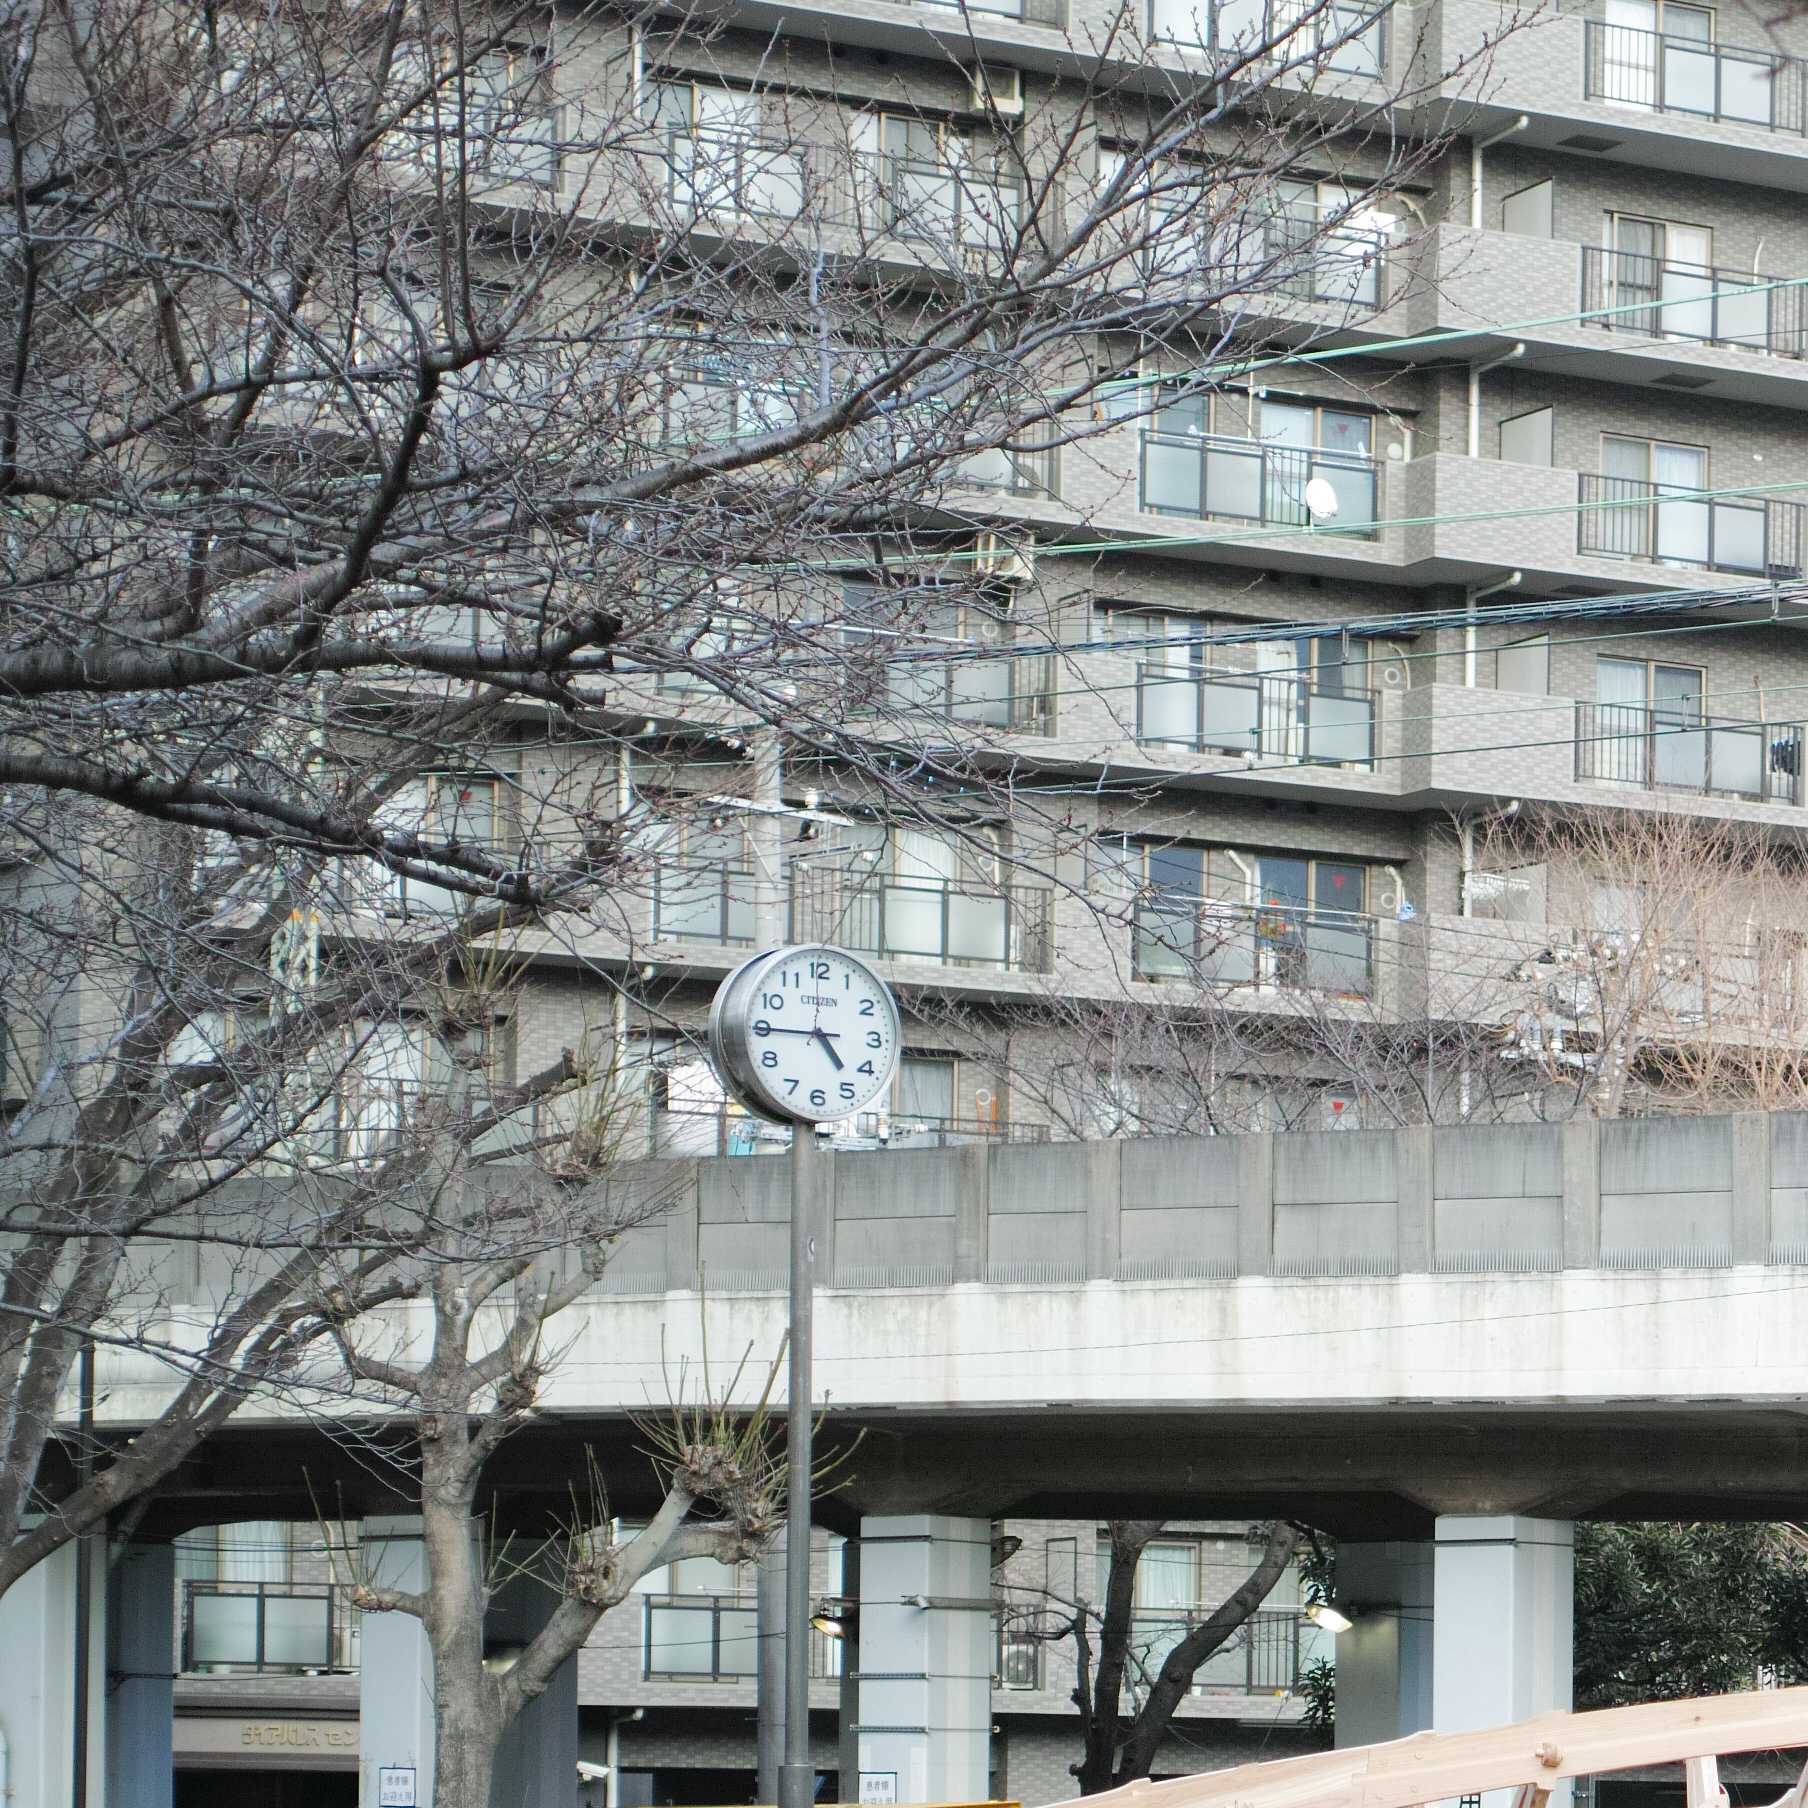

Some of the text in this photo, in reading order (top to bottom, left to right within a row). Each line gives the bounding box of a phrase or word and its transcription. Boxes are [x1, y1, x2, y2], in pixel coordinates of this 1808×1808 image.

[781, 970, 800, 989] 11
[809, 962, 830, 980] 12
[844, 974, 850, 990] 1
[762, 993, 784, 1010] 10
[800, 994, 838, 1008] CITIZEN
[859, 999, 874, 1017] 2
[754, 1019, 771, 1037] 9
[866, 1031, 882, 1049] 3
[761, 1050, 778, 1068] 8
[857, 1060, 875, 1077] 4
[783, 1078, 800, 1096] 7
[840, 1082, 855, 1100] 5
[810, 1089, 826, 1106] 6
